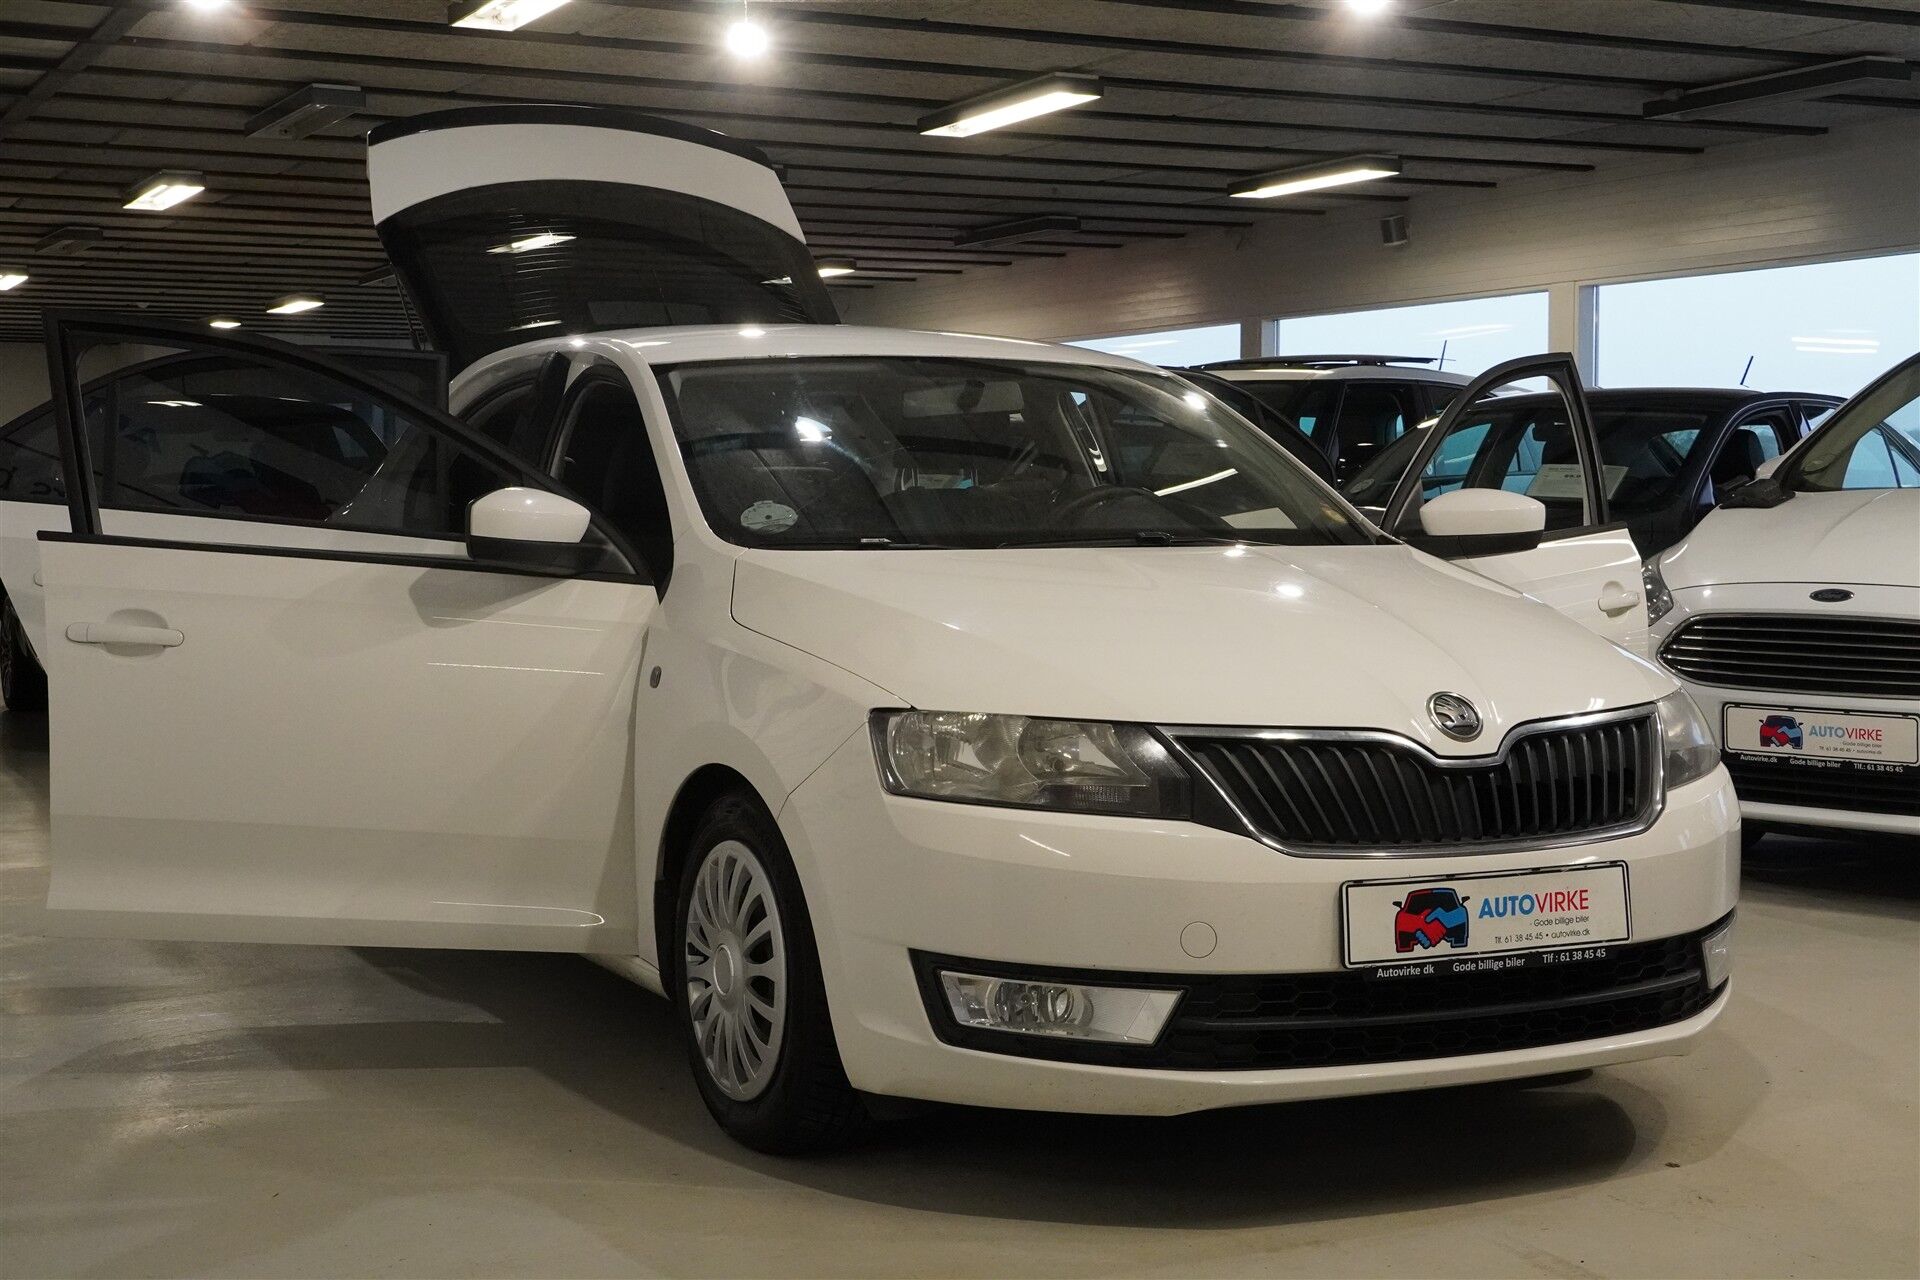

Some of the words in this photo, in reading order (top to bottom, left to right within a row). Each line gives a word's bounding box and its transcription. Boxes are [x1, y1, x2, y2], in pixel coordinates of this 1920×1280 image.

[1809, 725, 1882, 741] AUTOVIRKE
[1789, 758, 1806, 766] Gode
[1807, 759, 1826, 768] billige
[1826, 761, 1842, 769] biler
[1867, 763, 1874, 771] 61
[1478, 889, 1589, 919] AUTOVIRKE
[1533, 918, 1553, 927] Gode
[1554, 916, 1574, 926] billige
[1575, 915, 1590, 923] biler
[1504, 934, 1512, 943] 61
[1515, 933, 1524, 942] 38
[1524, 932, 1534, 941] 45
[1534, 931, 1544, 940] 45
[1551, 928, 1591, 939] autovirke.dk
[1453, 959, 1476, 972] Gode
[1478, 956, 1504, 971] billige
[1505, 956, 1526, 968] biler
[1560, 952, 1570, 962] 61
[1572, 950, 1583, 960] 38
[1584, 949, 1594, 959] 45
[1595, 948, 1606, 958] 45
